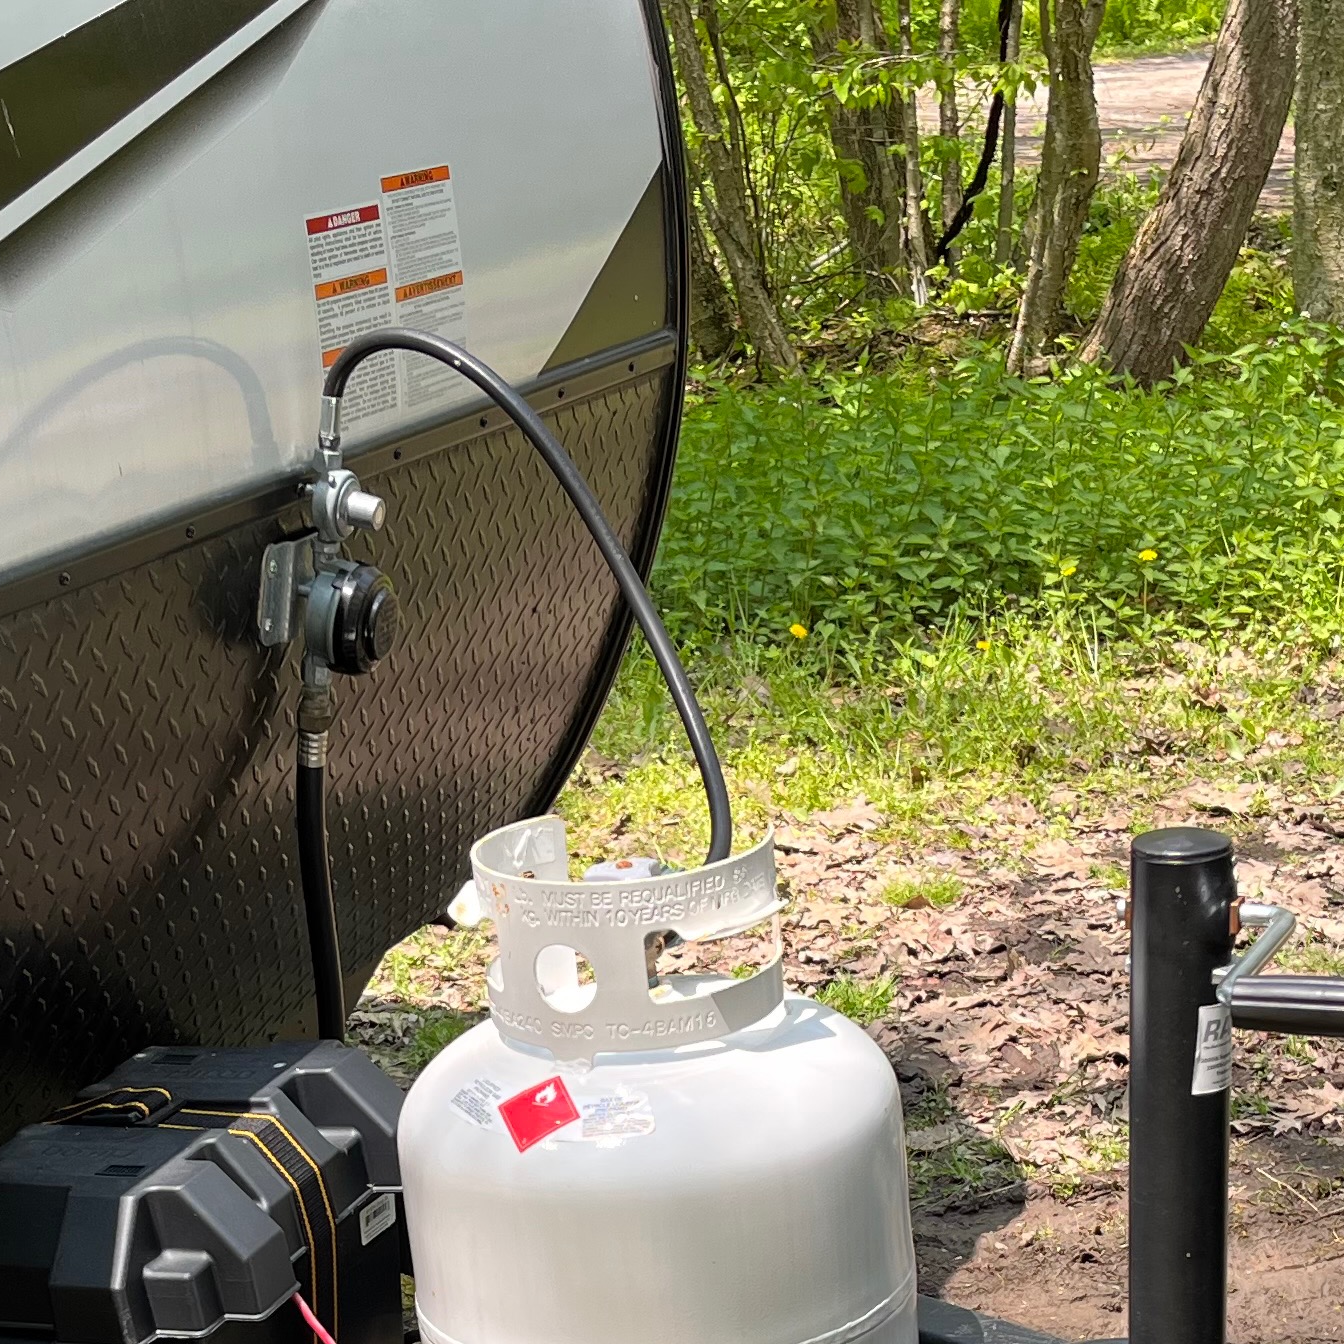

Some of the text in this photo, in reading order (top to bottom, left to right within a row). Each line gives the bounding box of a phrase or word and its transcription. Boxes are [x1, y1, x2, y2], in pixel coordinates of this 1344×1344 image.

[404, 170, 434, 186] WARNING
[333, 210, 360, 228] DANGER
[339, 275, 370, 293] WARNING
[542, 876, 725, 909] MUST BE REQUALIFIED
[545, 910, 600, 928] WITHIN
[606, 910, 629, 928] 10
[631, 905, 685, 925] YEARS
[689, 898, 709, 916] OF
